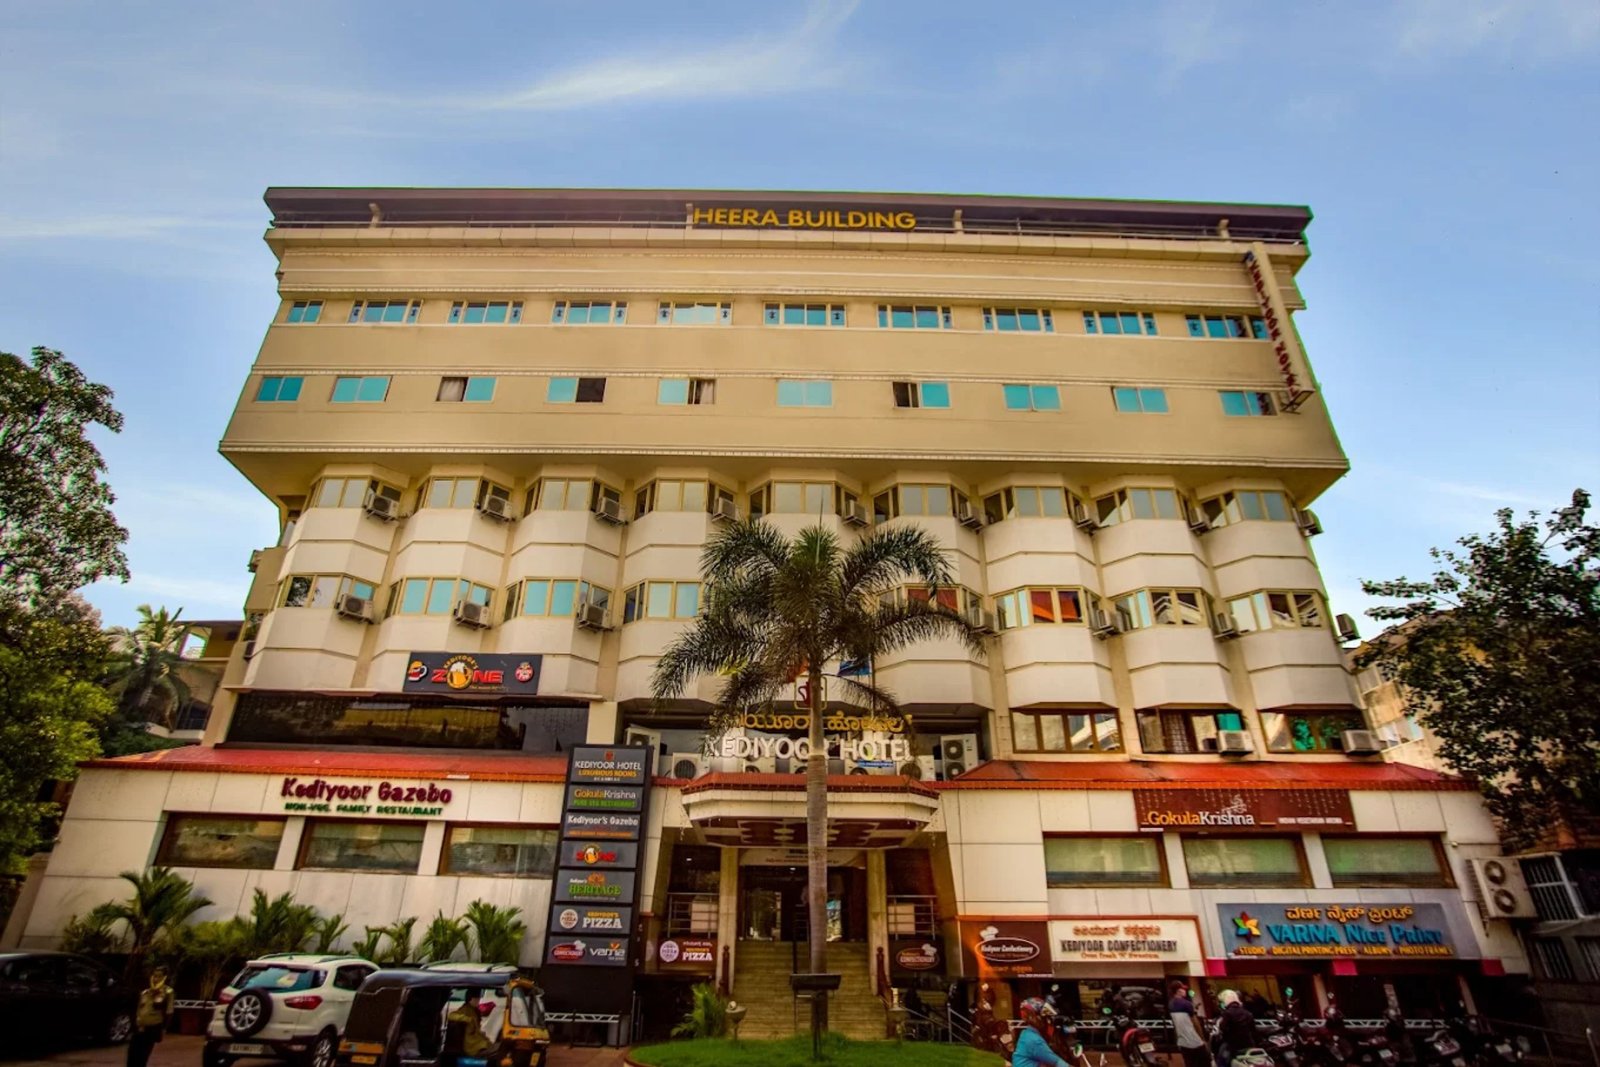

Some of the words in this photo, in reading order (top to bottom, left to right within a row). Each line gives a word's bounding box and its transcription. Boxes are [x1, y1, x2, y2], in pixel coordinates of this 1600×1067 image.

[693, 208, 779, 226] HEERA
[788, 210, 917, 229] BUILDING
[840, 738, 914, 762] HOTEL
[575, 761, 615, 769] KEDIYOOR
[617, 762, 641, 770] HOTEL
[281, 777, 373, 801] Kediyoor
[378, 782, 453, 804] Gazebo
[377, 805, 444, 816] RESTAURANT
[568, 815, 608, 825] Kediyoor's
[610, 816, 639, 826] Gazebo
[569, 884, 622, 895] HERITAGE
[582, 917, 623, 929] PIZZA
[1267, 923, 1341, 945] VARNA
[1061, 940, 1105, 952] KEDIYOOR
[1108, 940, 1177, 952] CONFECTIONERY
[682, 952, 713, 961] PIZZA
